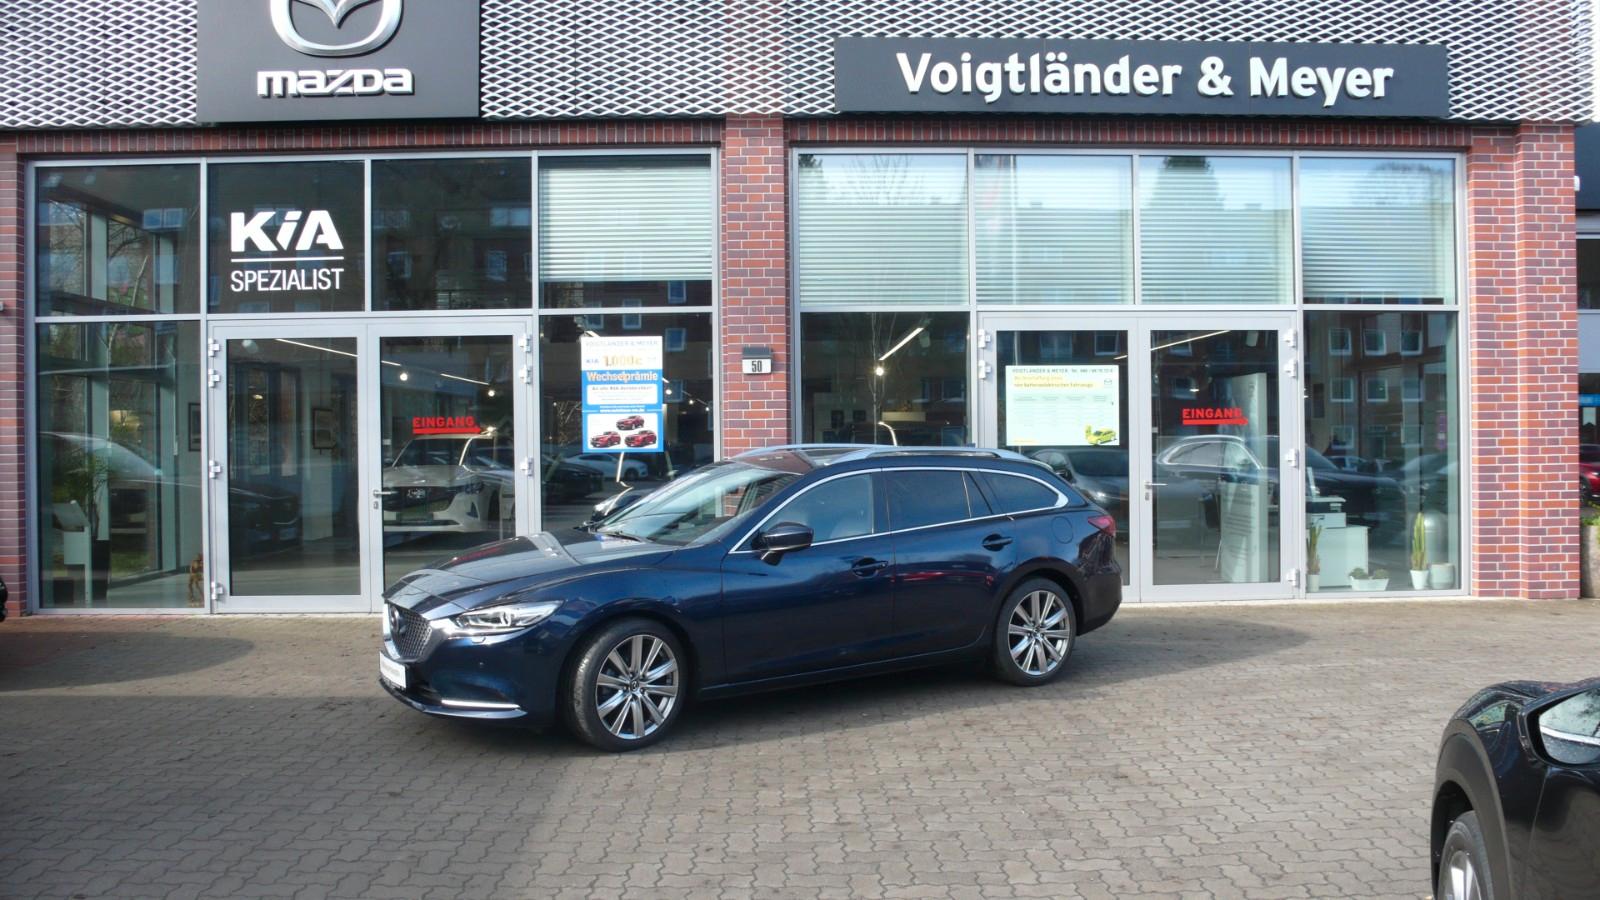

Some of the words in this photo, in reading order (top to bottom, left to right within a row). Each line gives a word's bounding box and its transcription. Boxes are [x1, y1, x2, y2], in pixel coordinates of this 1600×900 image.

[896, 51, 1183, 104] Voigtländer
[1197, 56, 1235, 97] &
[1249, 56, 1395, 107] Meyer
[230, 268, 345, 292] SPEZIALIST
[751, 360, 763, 373] 50
[1182, 408, 1243, 419] EINGANG
[412, 416, 475, 428] EINGANG
